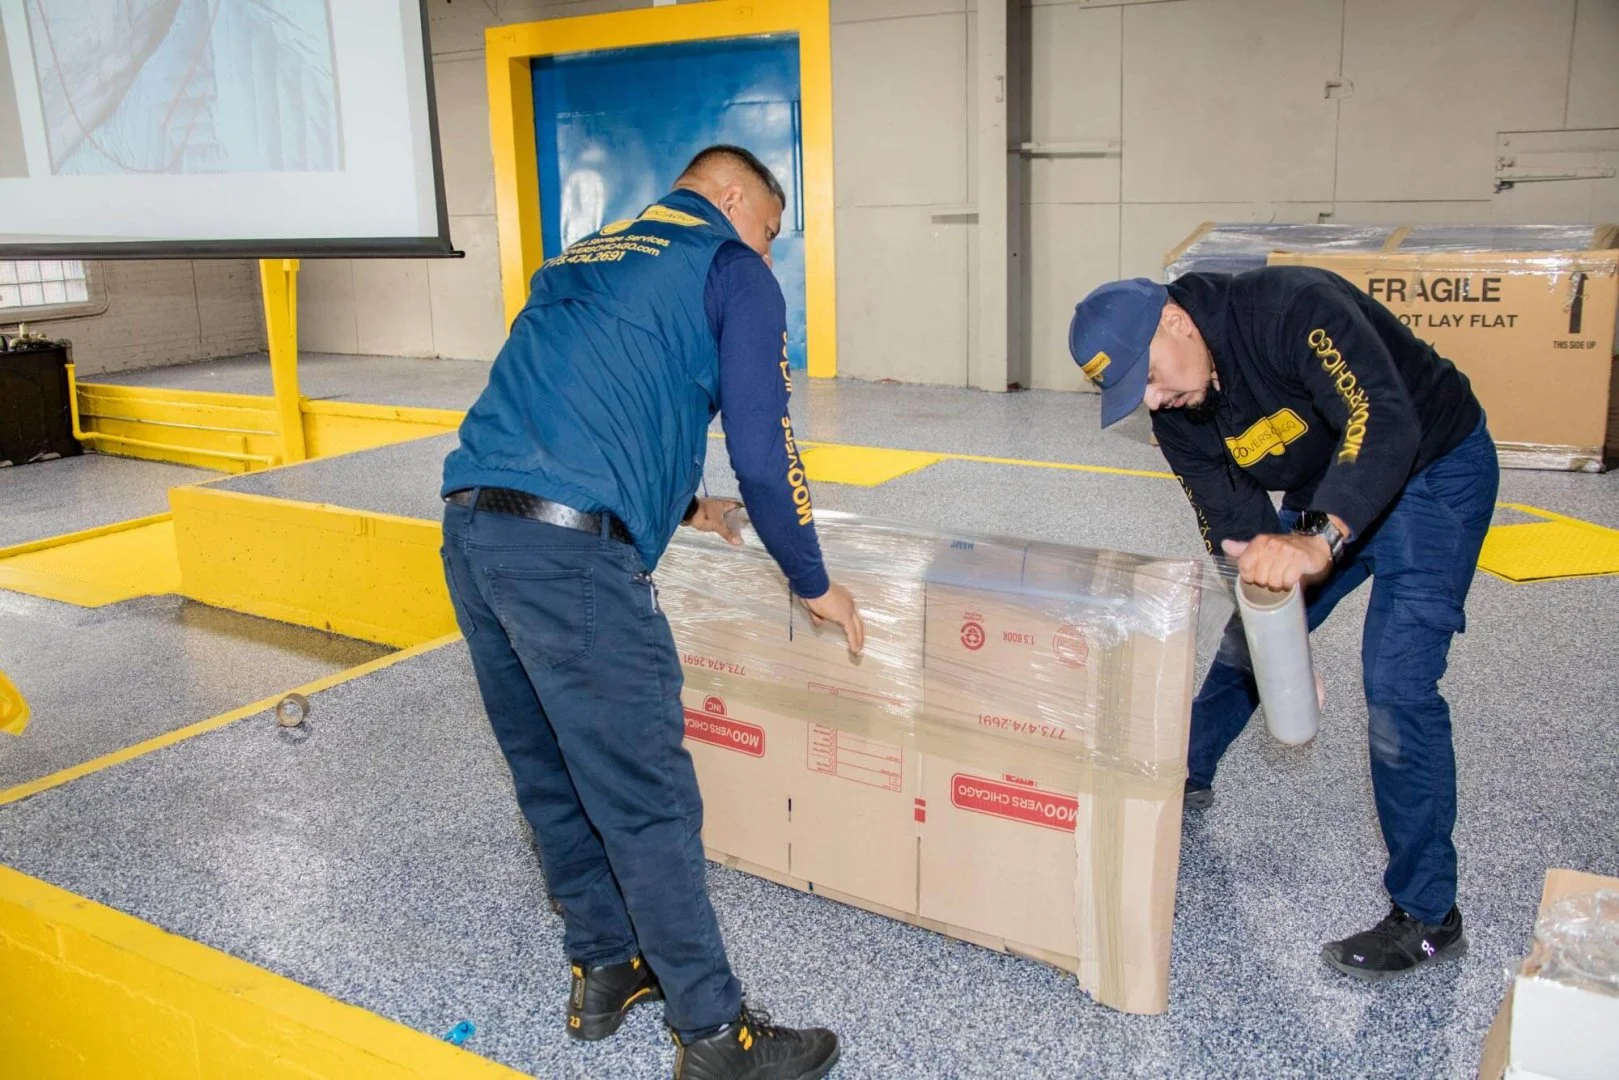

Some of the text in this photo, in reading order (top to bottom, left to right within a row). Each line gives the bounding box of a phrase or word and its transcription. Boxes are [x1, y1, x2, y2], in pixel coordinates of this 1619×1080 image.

[627, 234, 671, 248] Services
[1368, 277, 1502, 303] FRAGILE
[1398, 313, 1519, 328] OT LAY FLAT
[1552, 340, 1597, 349] THIS SIDE UP
[1231, 429, 1272, 459] OOVERS
[683, 653, 746, 677] 773.474.2691
[709, 723, 760, 748] MOOVERS
[978, 714, 1067, 741] 773.474.2691
[958, 784, 1079, 823] MOOVERS CHICAGO
[568, 1015, 582, 1029] 23
